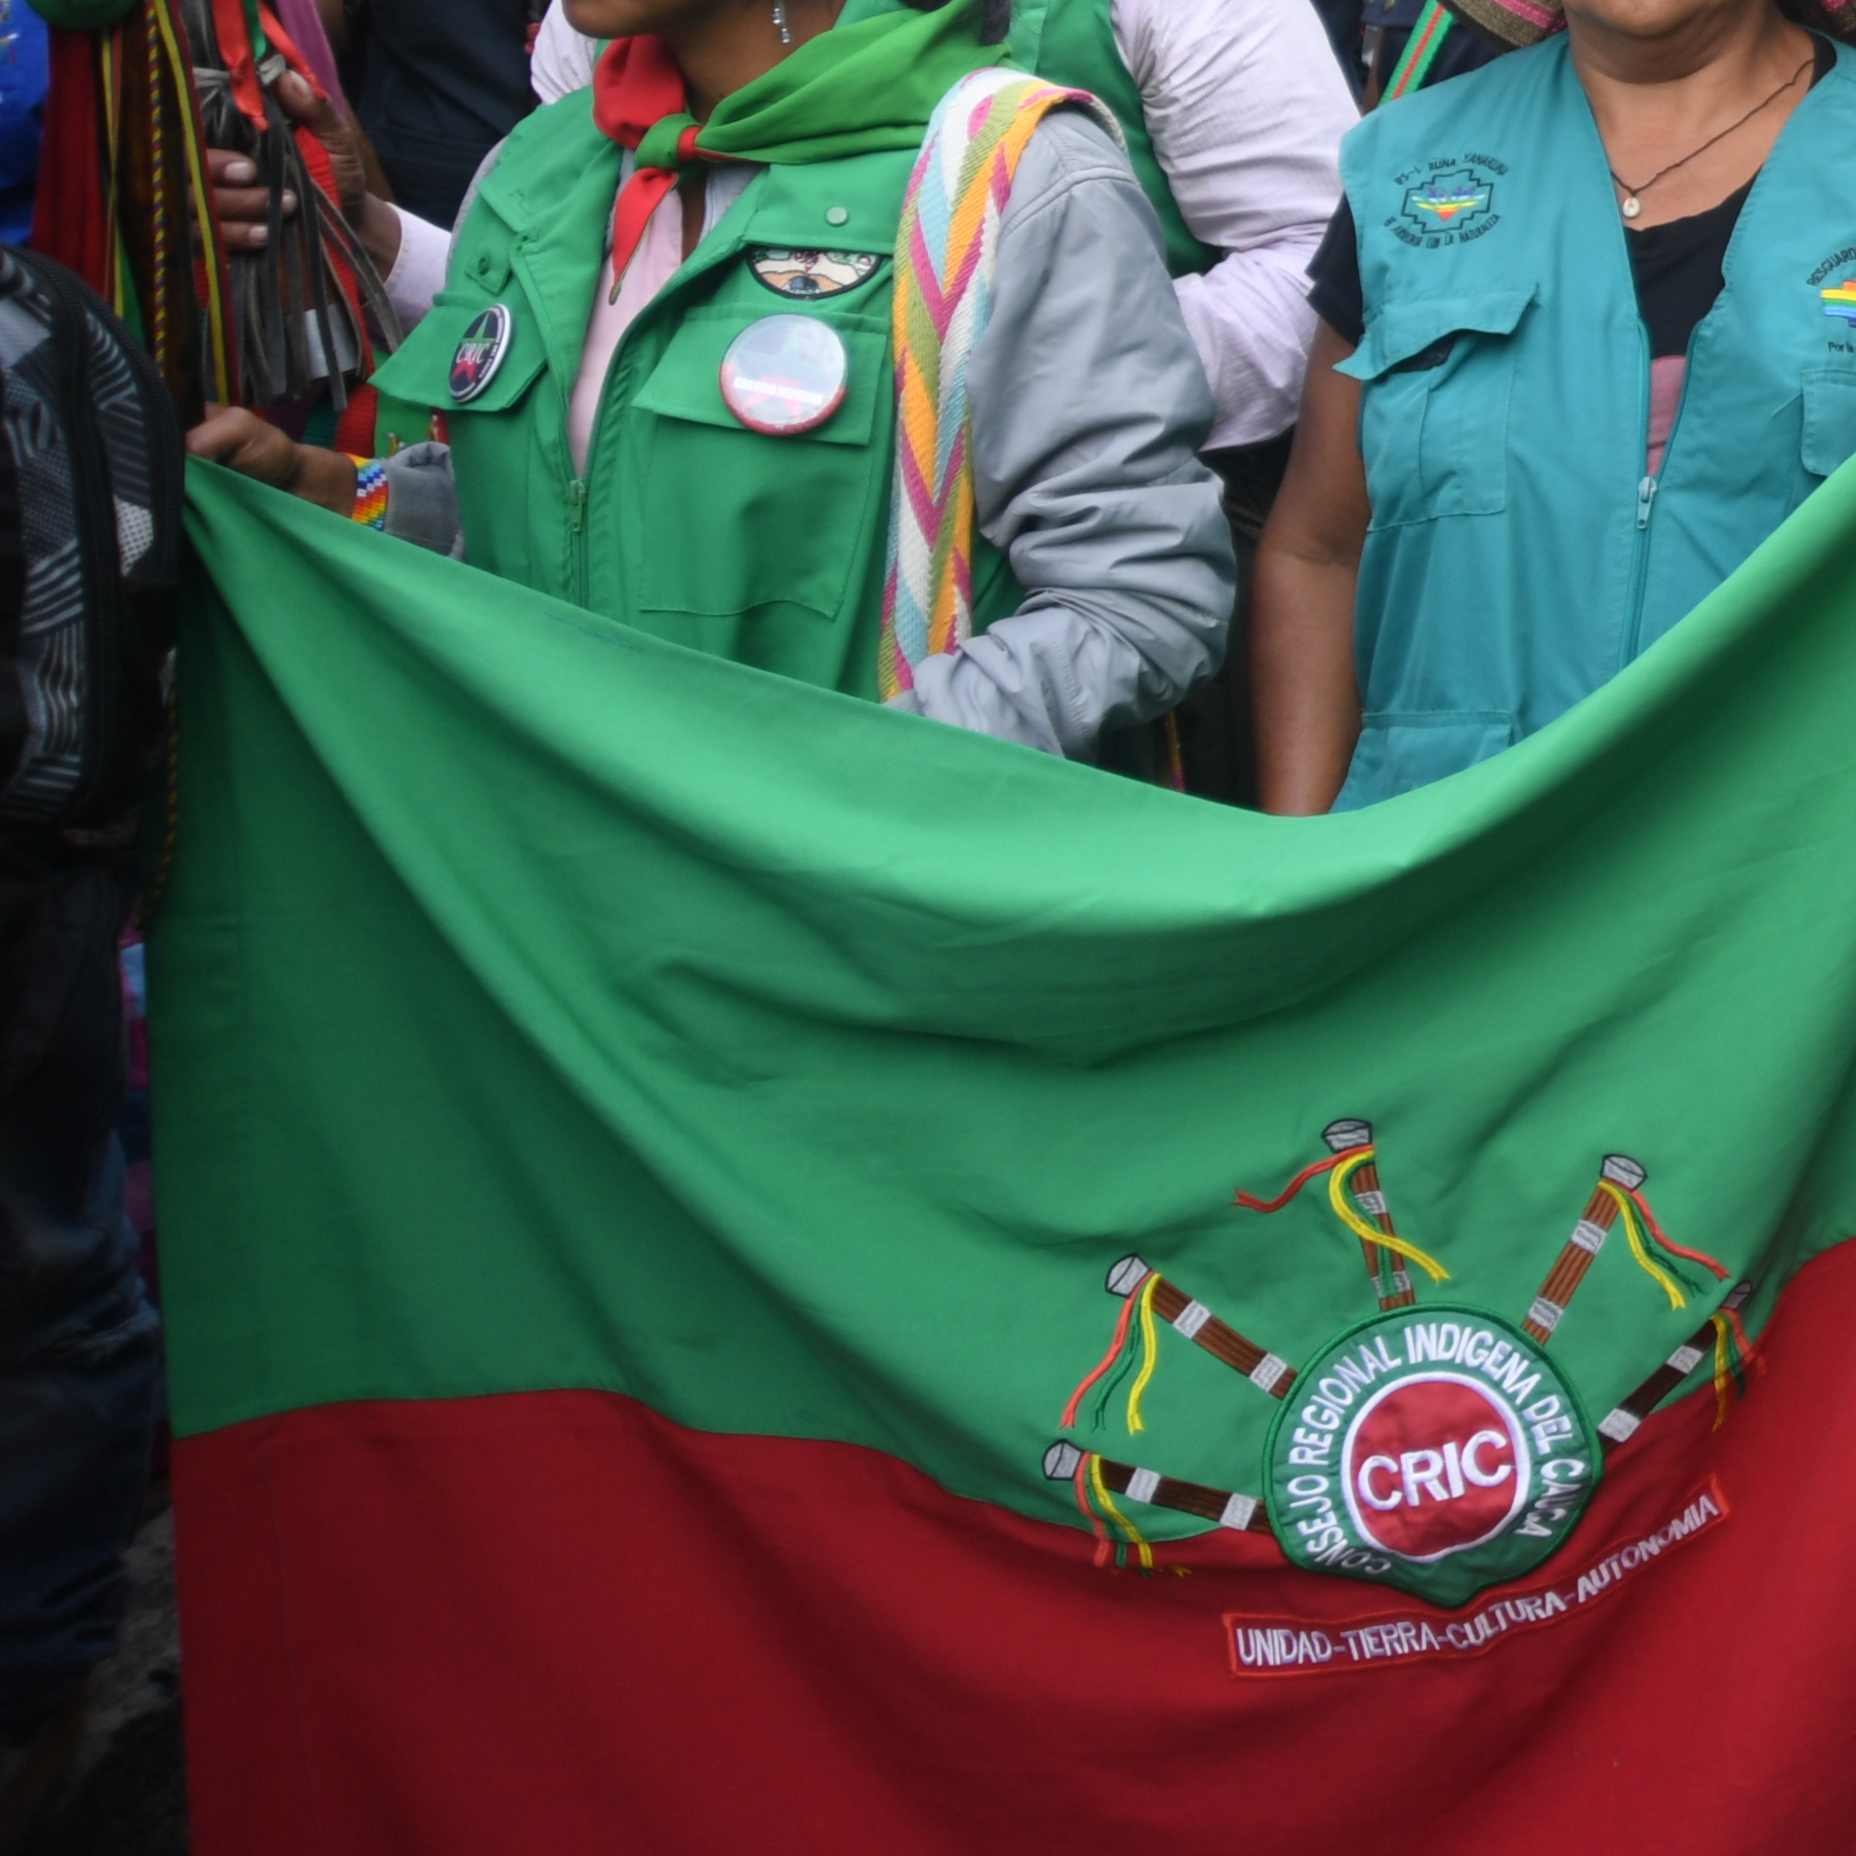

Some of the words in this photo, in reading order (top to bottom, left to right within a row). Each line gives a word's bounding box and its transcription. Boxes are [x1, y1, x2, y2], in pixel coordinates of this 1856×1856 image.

[1827, 341, 1844, 352] Por
[1288, 1336, 1402, 1466] REGIONAL
[1403, 1322, 1541, 1406] INDIGENA
[1522, 1395, 1573, 1455] DEL
[1357, 1430, 1511, 1511] CRIC
[1287, 1474, 1391, 1575] CONSEJO
